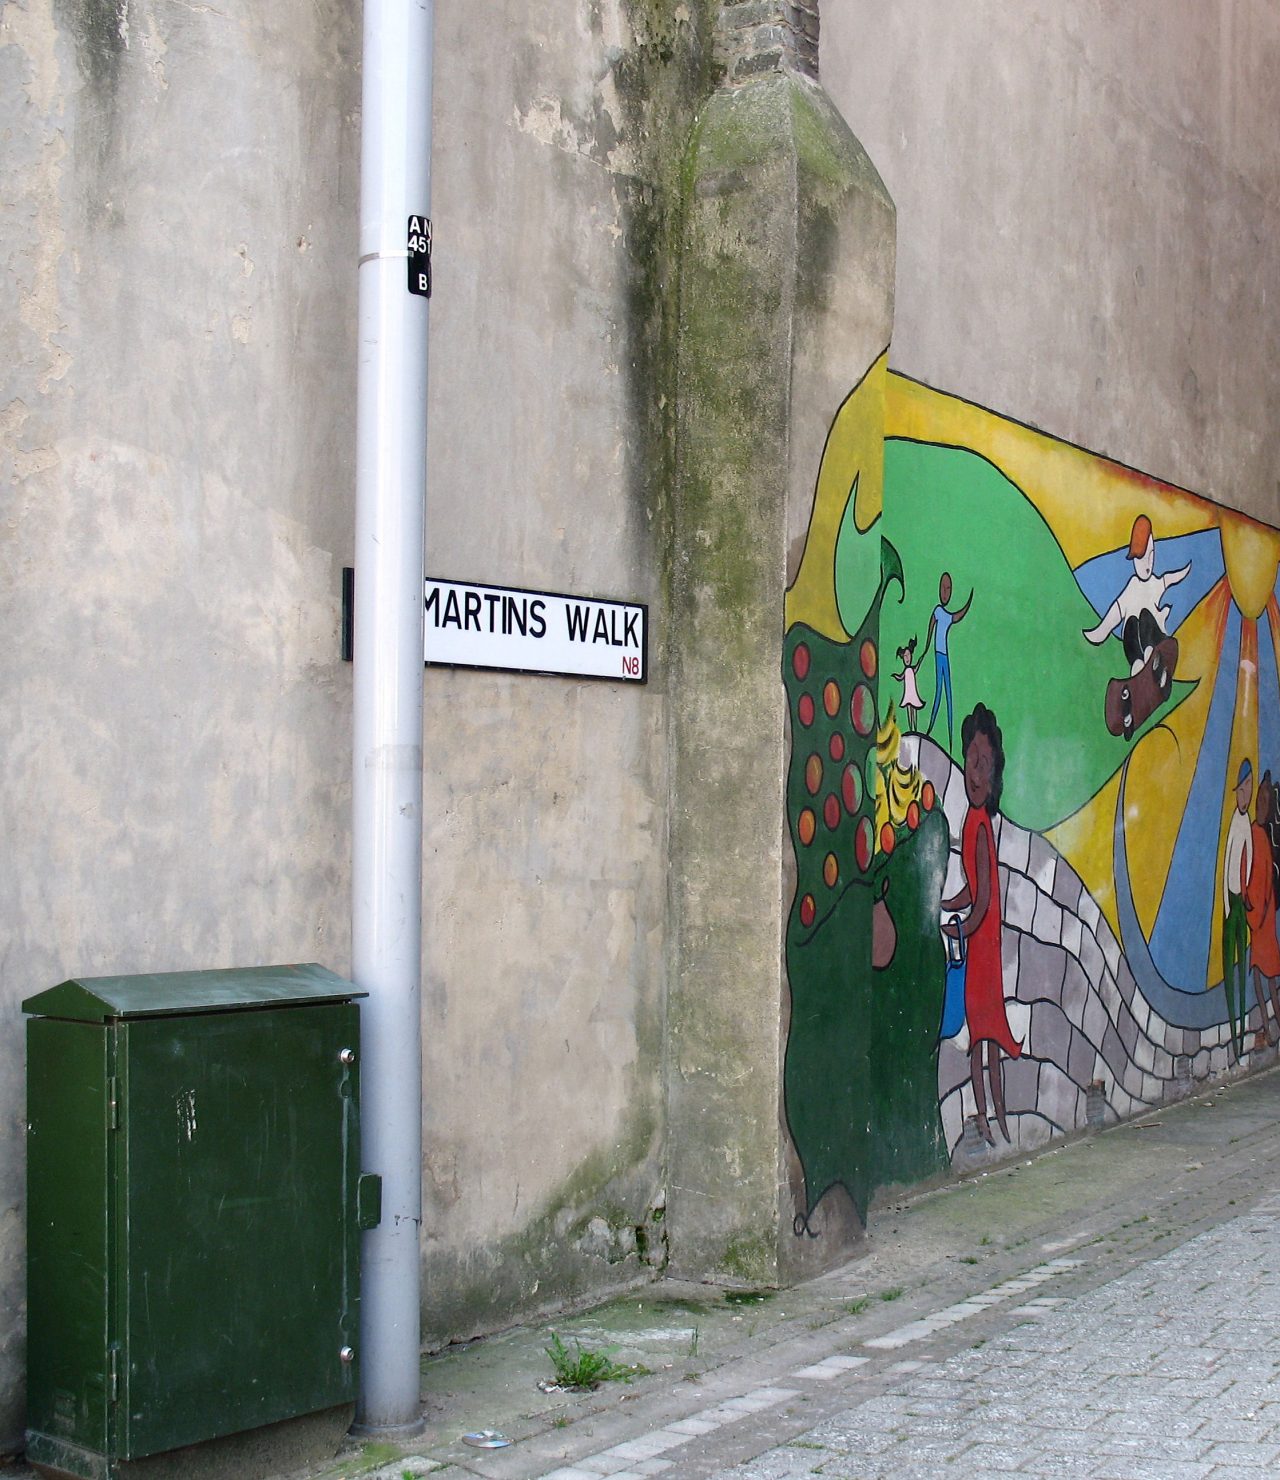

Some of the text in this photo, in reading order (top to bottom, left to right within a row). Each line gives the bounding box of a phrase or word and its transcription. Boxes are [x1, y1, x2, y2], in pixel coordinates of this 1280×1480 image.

[418, 273, 428, 290] B
[565, 603, 640, 648] WALK
[622, 656, 640, 675] N8
